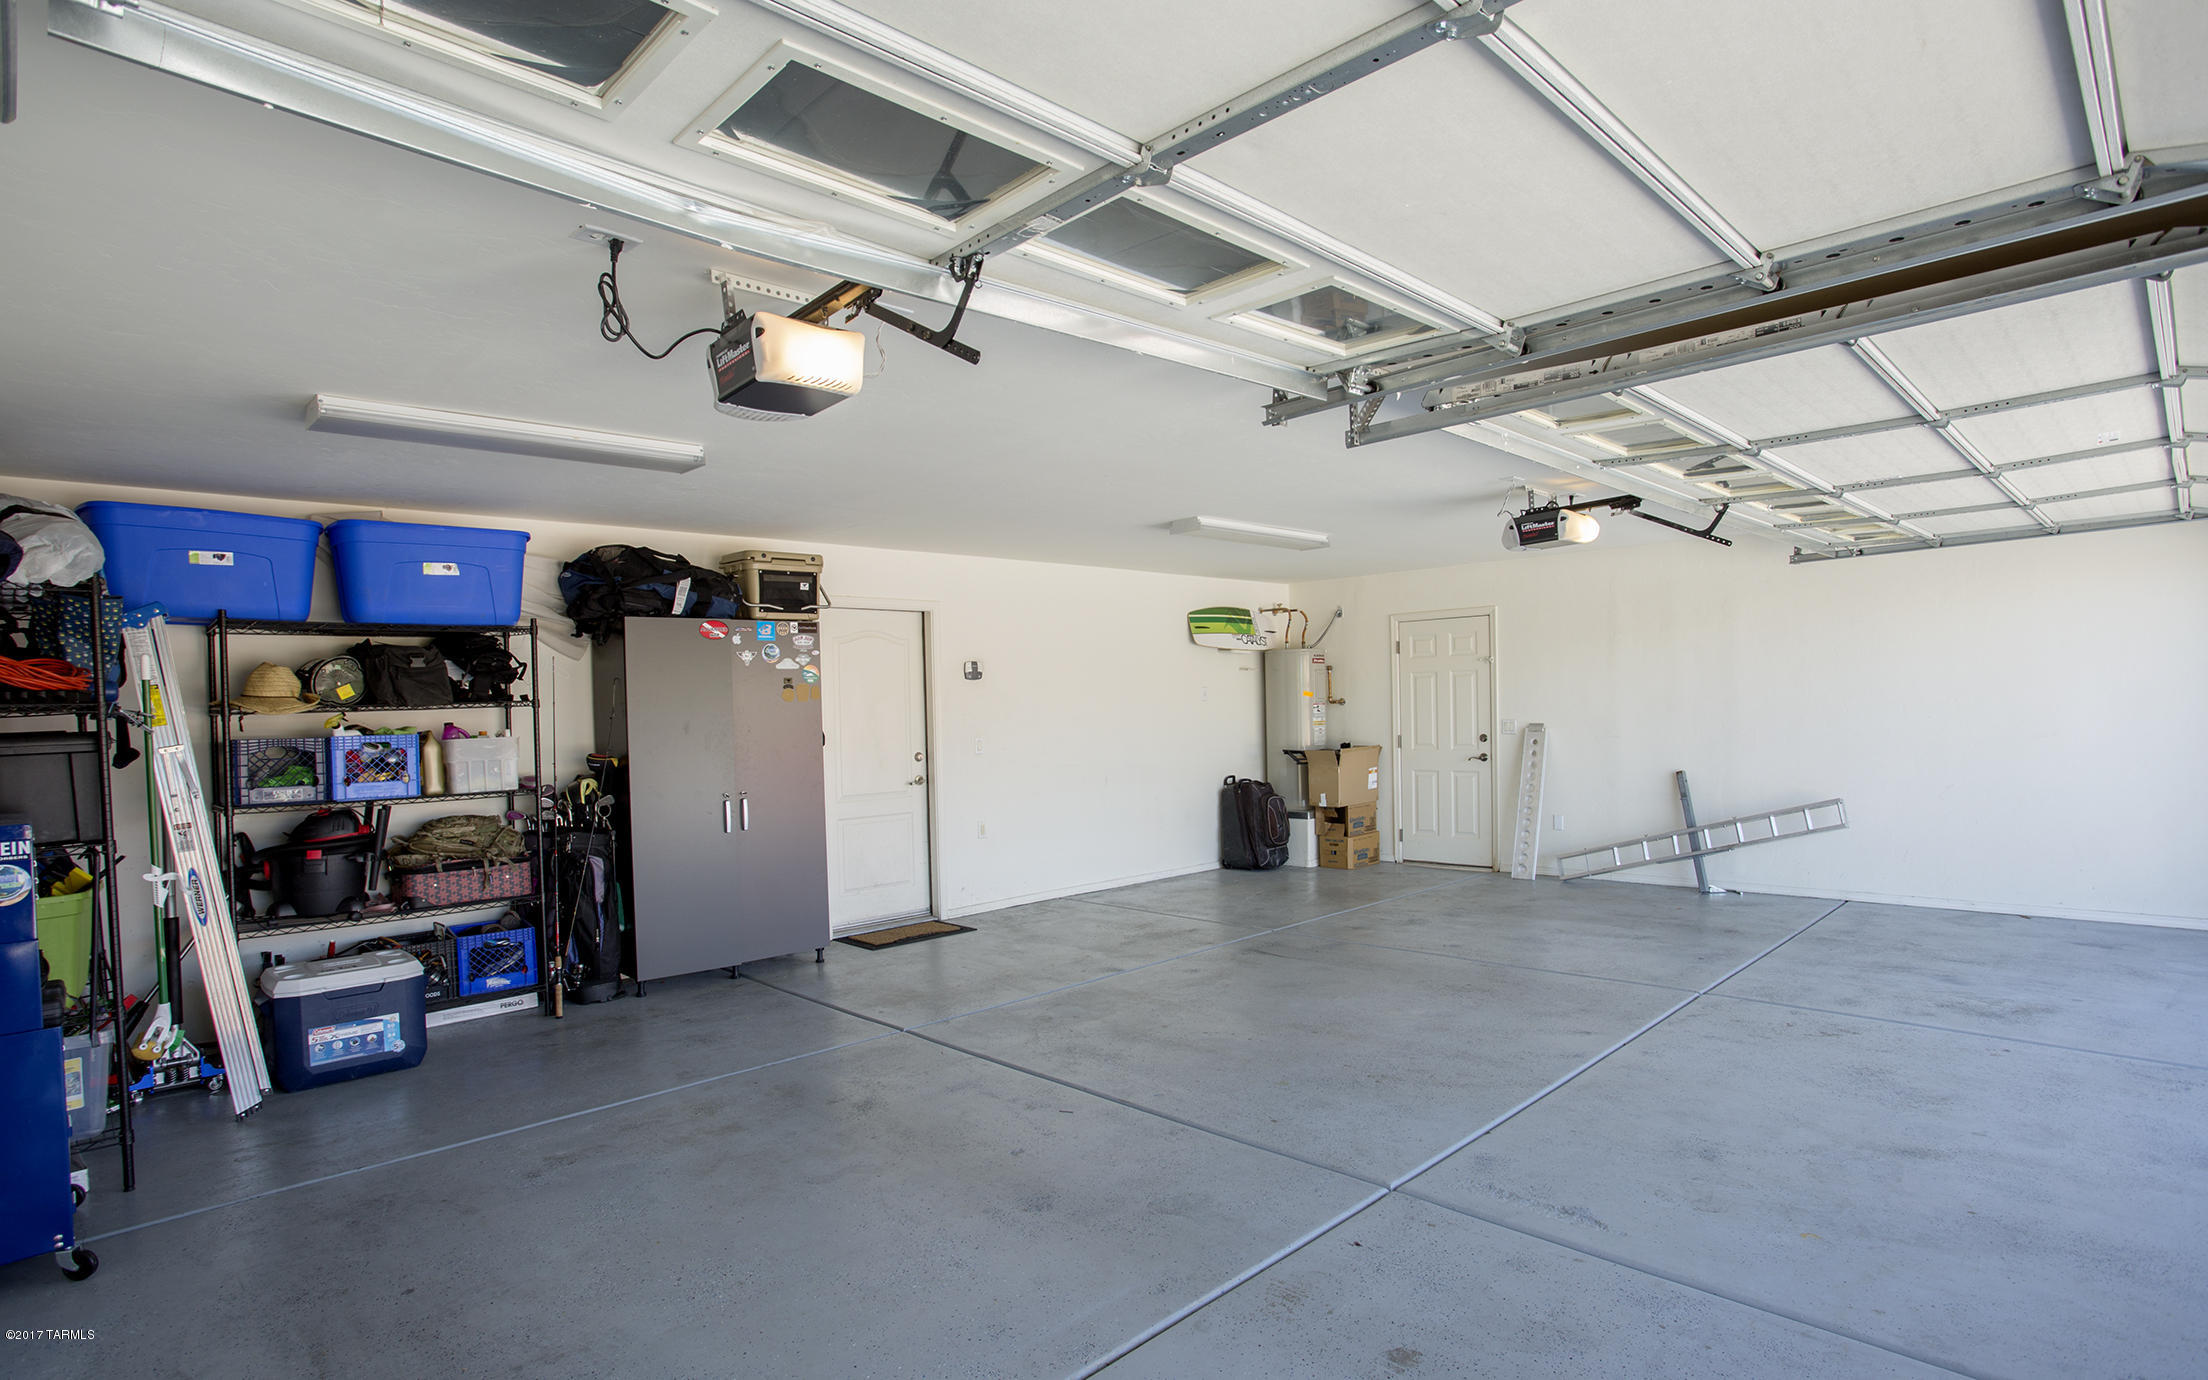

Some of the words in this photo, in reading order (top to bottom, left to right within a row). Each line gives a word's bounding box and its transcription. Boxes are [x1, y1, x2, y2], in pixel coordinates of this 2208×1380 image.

[716, 341, 751, 368] LiftMaster
[1521, 521, 1555, 530] LiftMaster
[191, 879, 205, 914] WERNER
[500, 999, 524, 1008] PERGO
